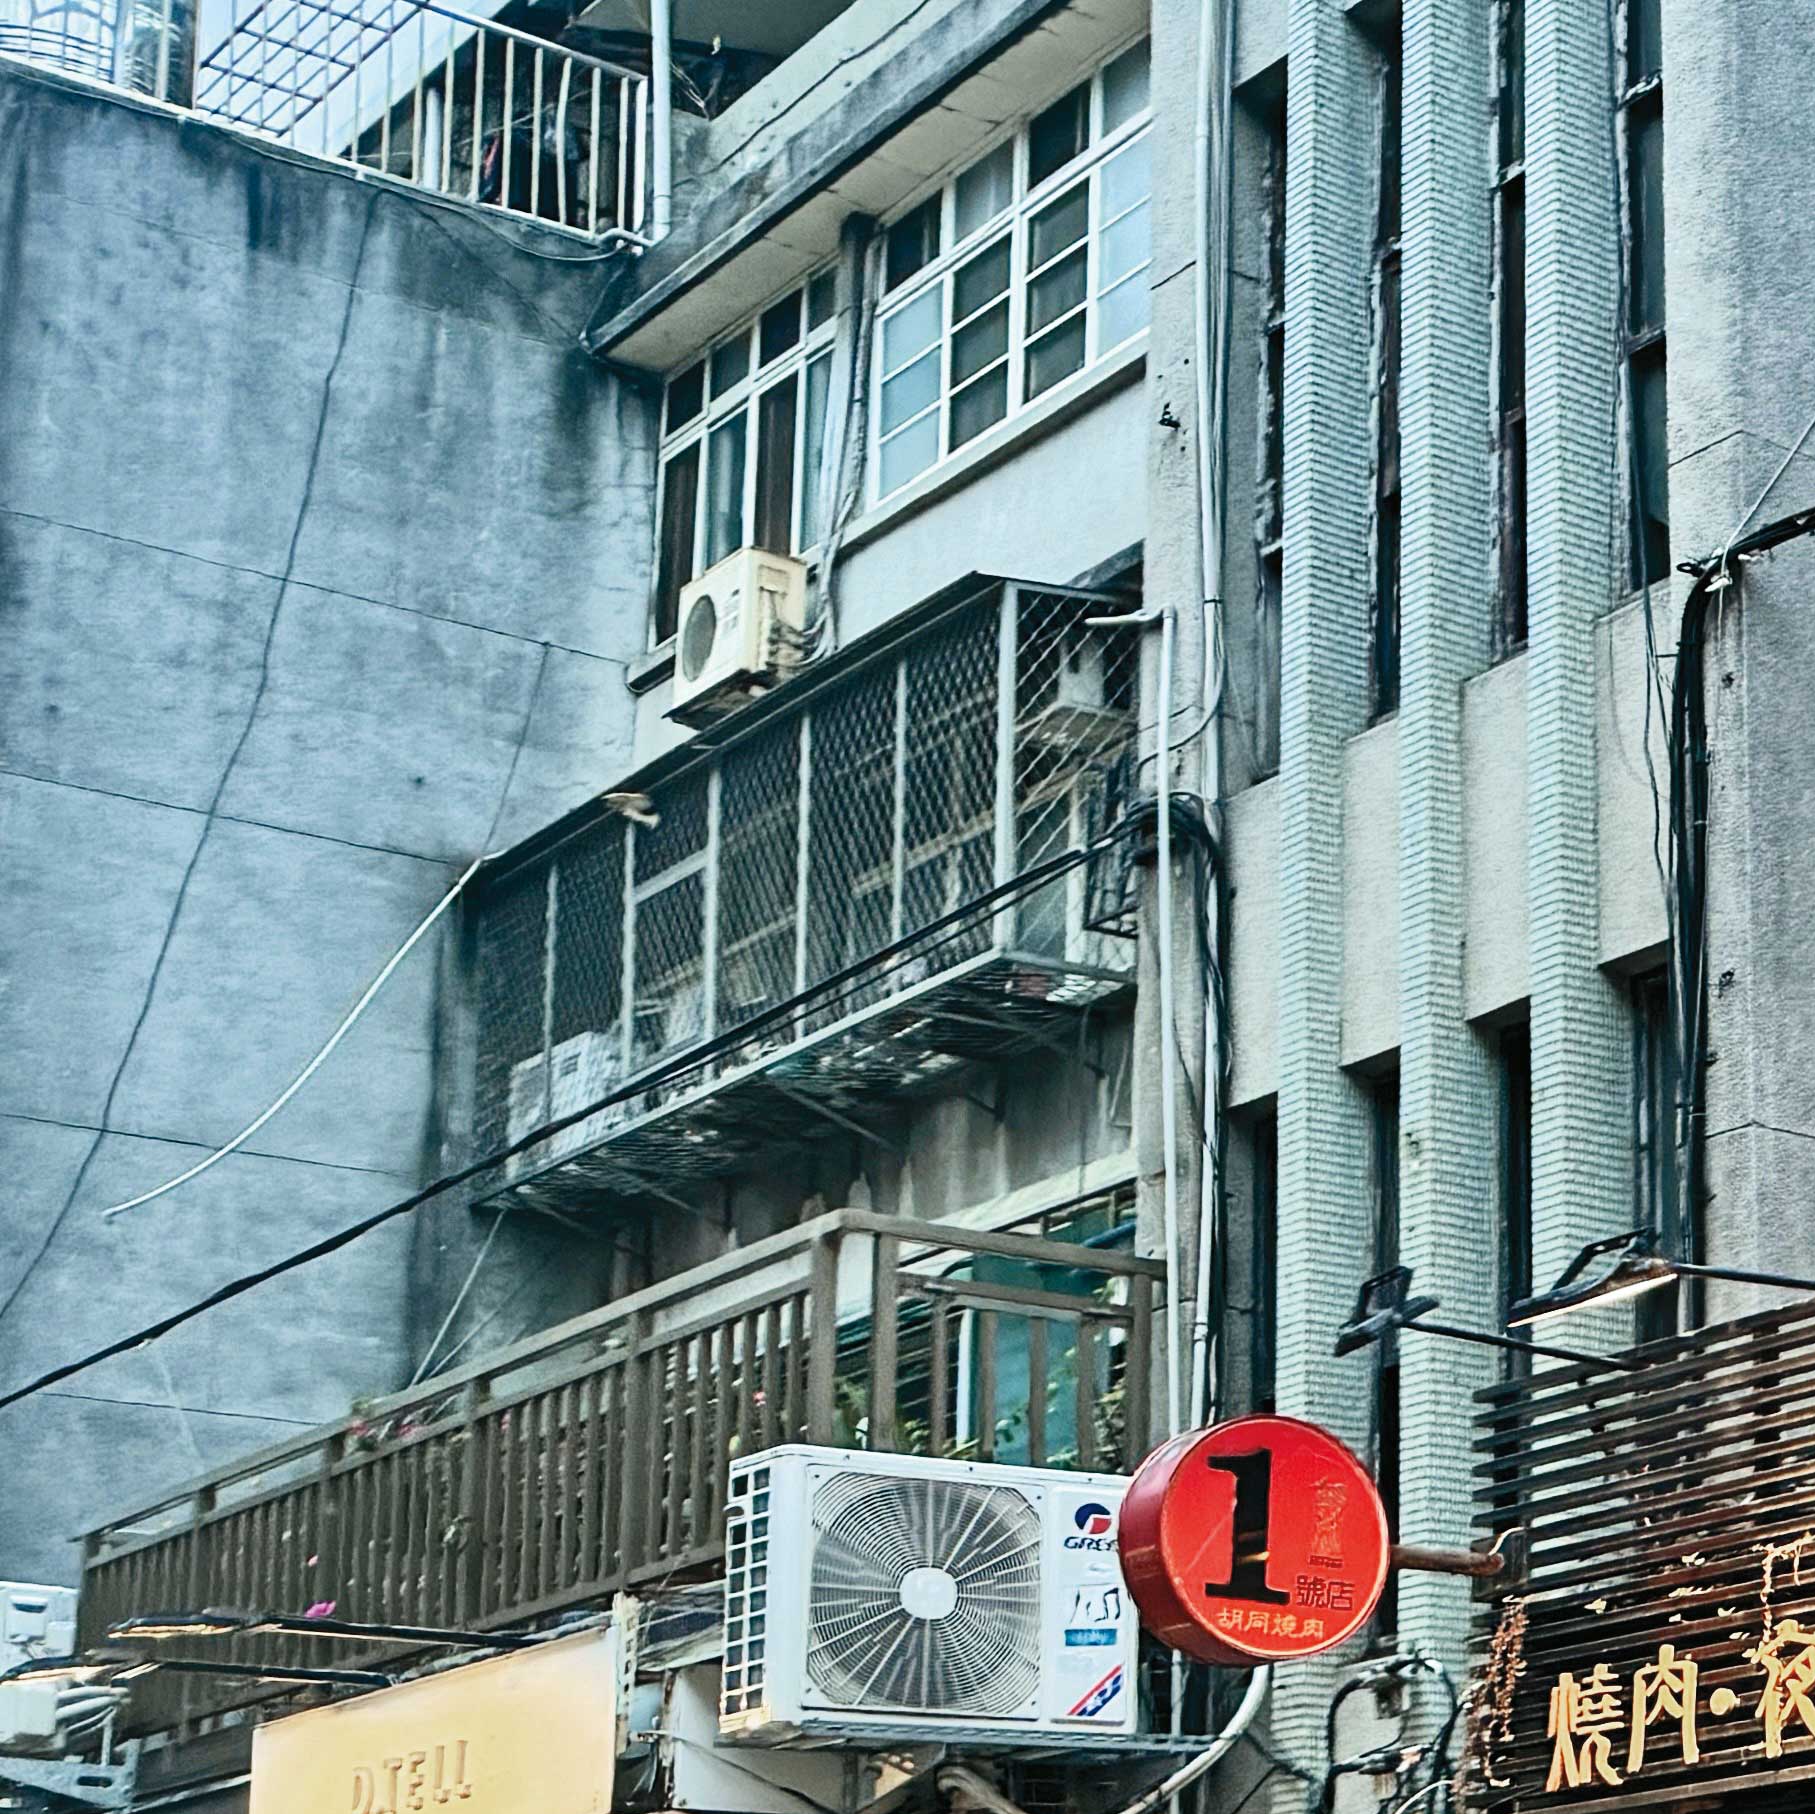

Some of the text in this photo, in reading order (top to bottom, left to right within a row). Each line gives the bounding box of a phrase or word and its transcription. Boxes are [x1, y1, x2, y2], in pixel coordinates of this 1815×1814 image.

[1205, 1447, 1355, 1611] 1 號店
[1216, 1607, 1325, 1639] 胡同燒肉
